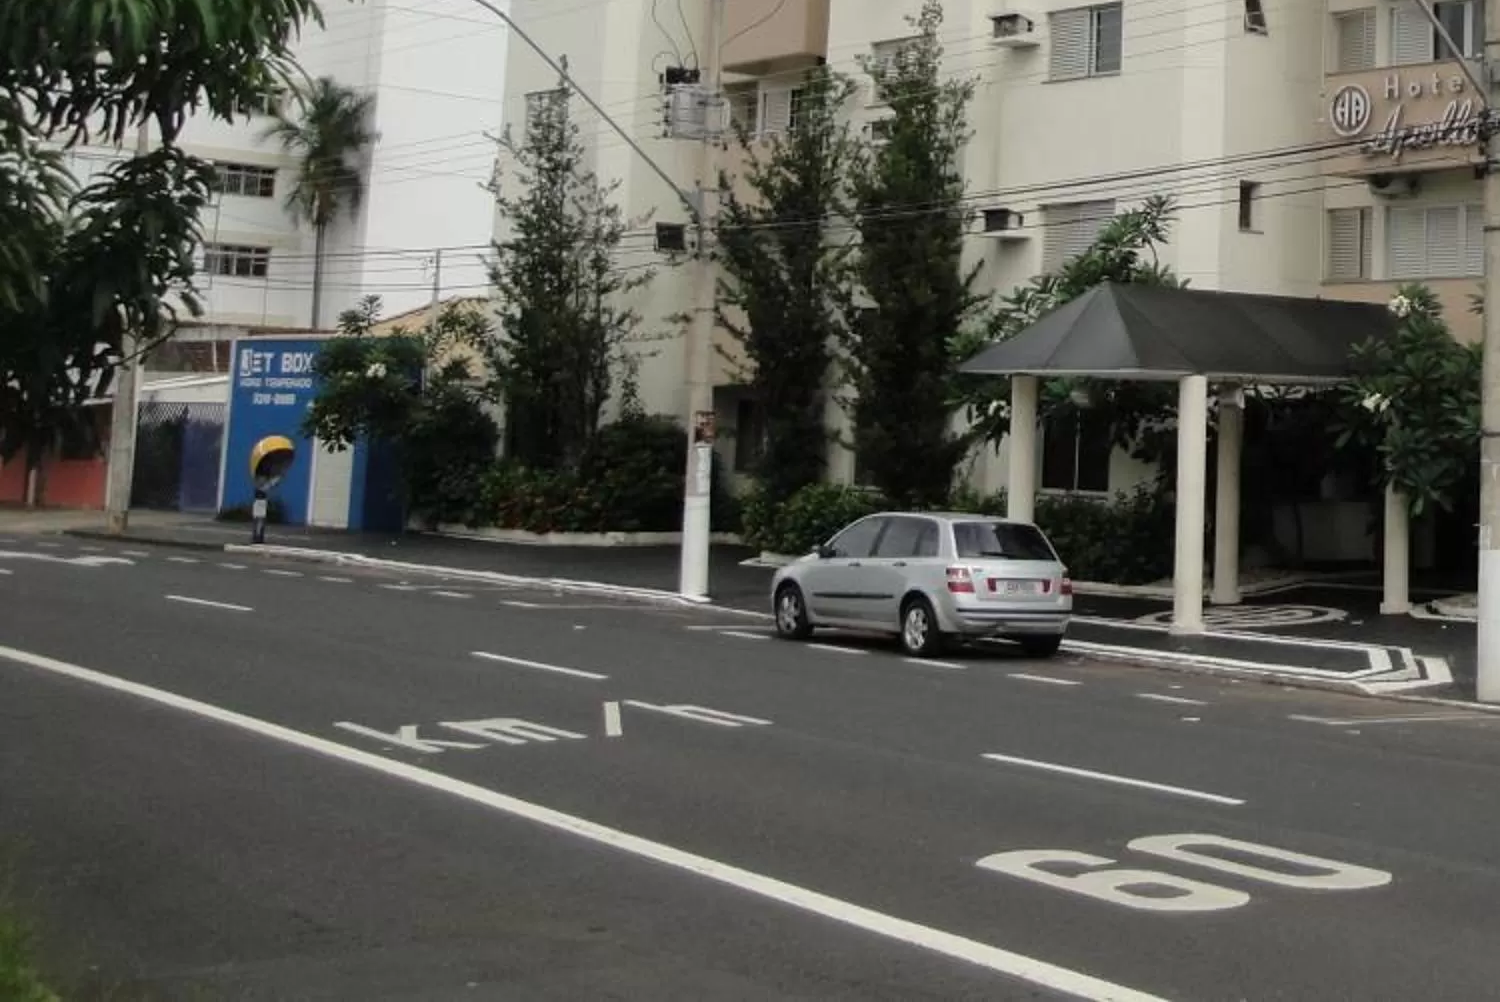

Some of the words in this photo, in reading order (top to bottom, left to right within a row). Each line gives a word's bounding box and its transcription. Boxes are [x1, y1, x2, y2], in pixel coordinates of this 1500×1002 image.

[1385, 72, 1464, 99] Hote
[281, 352, 314, 374] BOX
[975, 833, 1393, 912] 60
